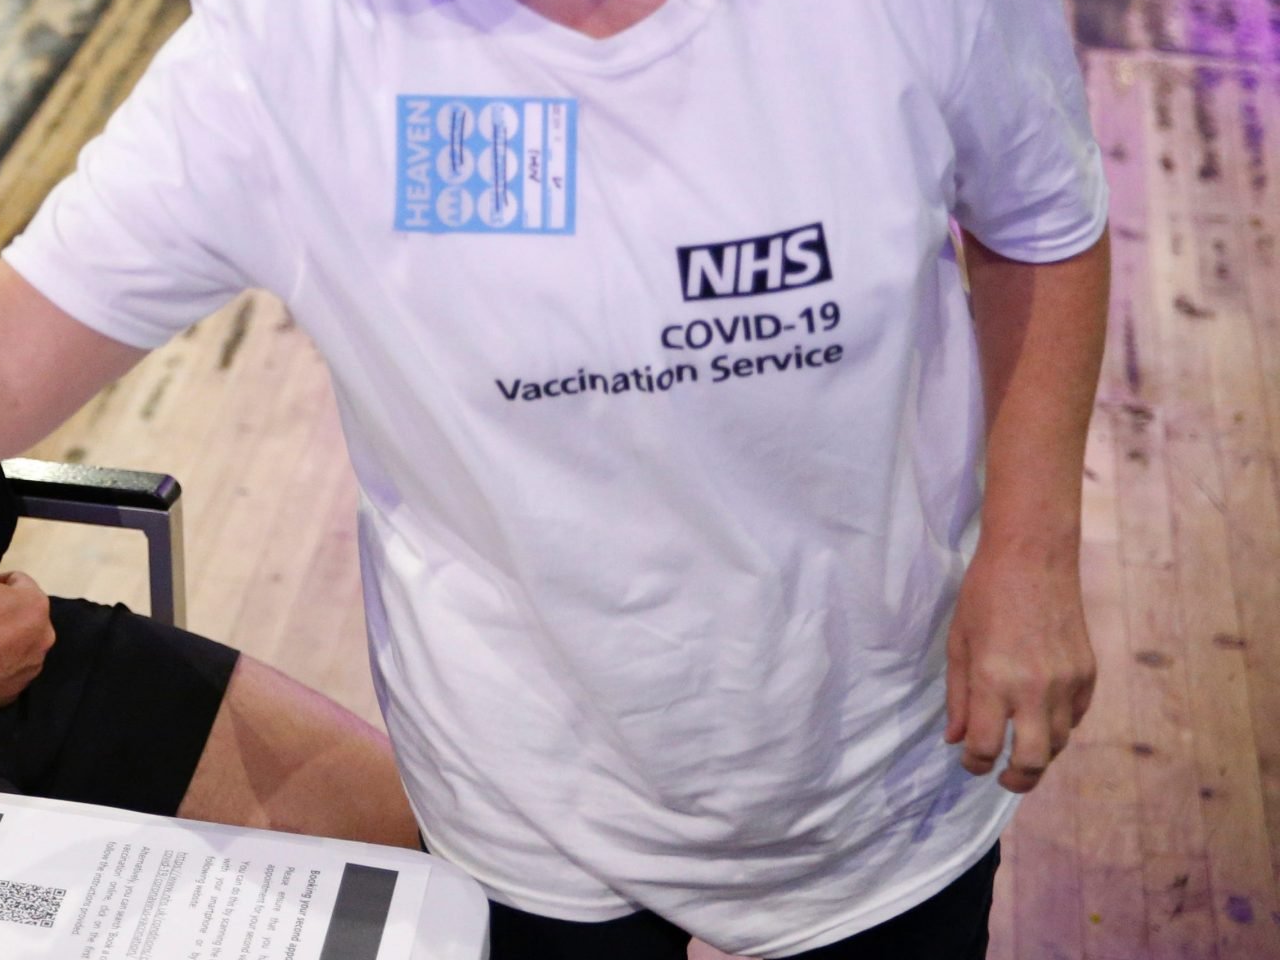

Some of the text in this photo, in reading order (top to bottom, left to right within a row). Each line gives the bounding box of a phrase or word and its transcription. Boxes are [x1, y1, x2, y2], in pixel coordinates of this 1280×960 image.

[405, 99, 430, 228] HEAVEN
[686, 226, 823, 298] NHS
[660, 301, 842, 352] COVID-19
[495, 342, 845, 402] Vaccination Service
[101, 841, 117, 861] follow
[96, 861, 109, 872] the
[195, 856, 216, 884] following
[280, 866, 296, 886] Please
[82, 872, 104, 907] instructions
[123, 885, 134, 898] you
[301, 869, 321, 899] Booking
[97, 905, 110, 918] click
[119, 898, 129, 910] can
[189, 858, 231, 960] with your smartphone or by
[210, 861, 251, 958] You can do this by scanning the
[241, 864, 276, 954] appointment for your second
[272, 891, 286, 912] ensure
[298, 899, 311, 917] your
[93, 920, 102, 929] on
[111, 910, 125, 930] search
[266, 917, 279, 931] that
[291, 917, 305, 942] second
[87, 932, 99, 943] the
[261, 936, 272, 949] you
